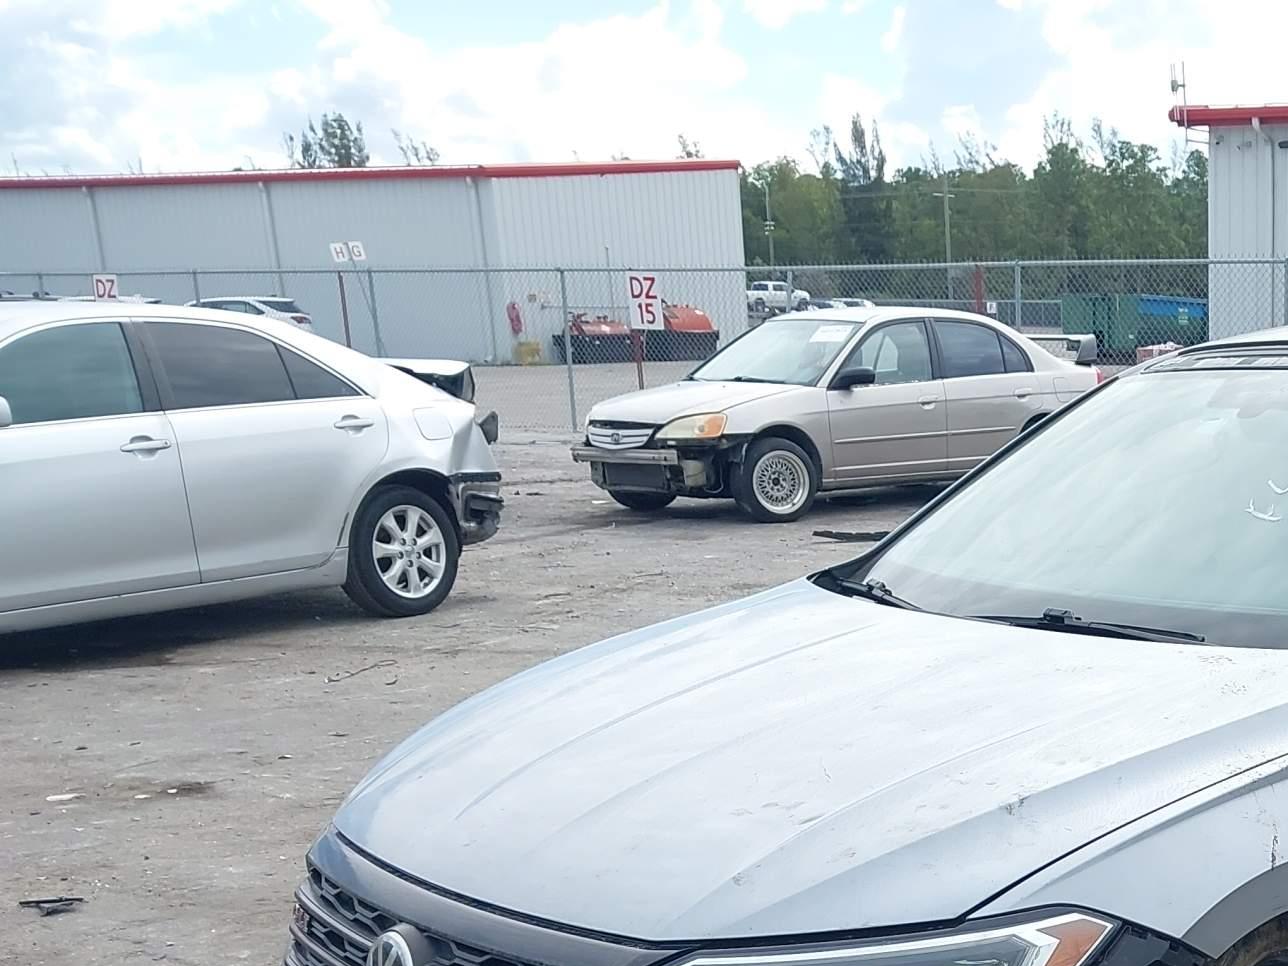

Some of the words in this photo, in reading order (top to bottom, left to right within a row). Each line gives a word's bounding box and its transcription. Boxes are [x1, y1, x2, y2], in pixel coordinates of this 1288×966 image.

[334, 246, 345, 260] H
[351, 245, 362, 258] G
[95, 278, 117, 299] DZ
[629, 276, 658, 300] DZ
[637, 302, 657, 325] 15
